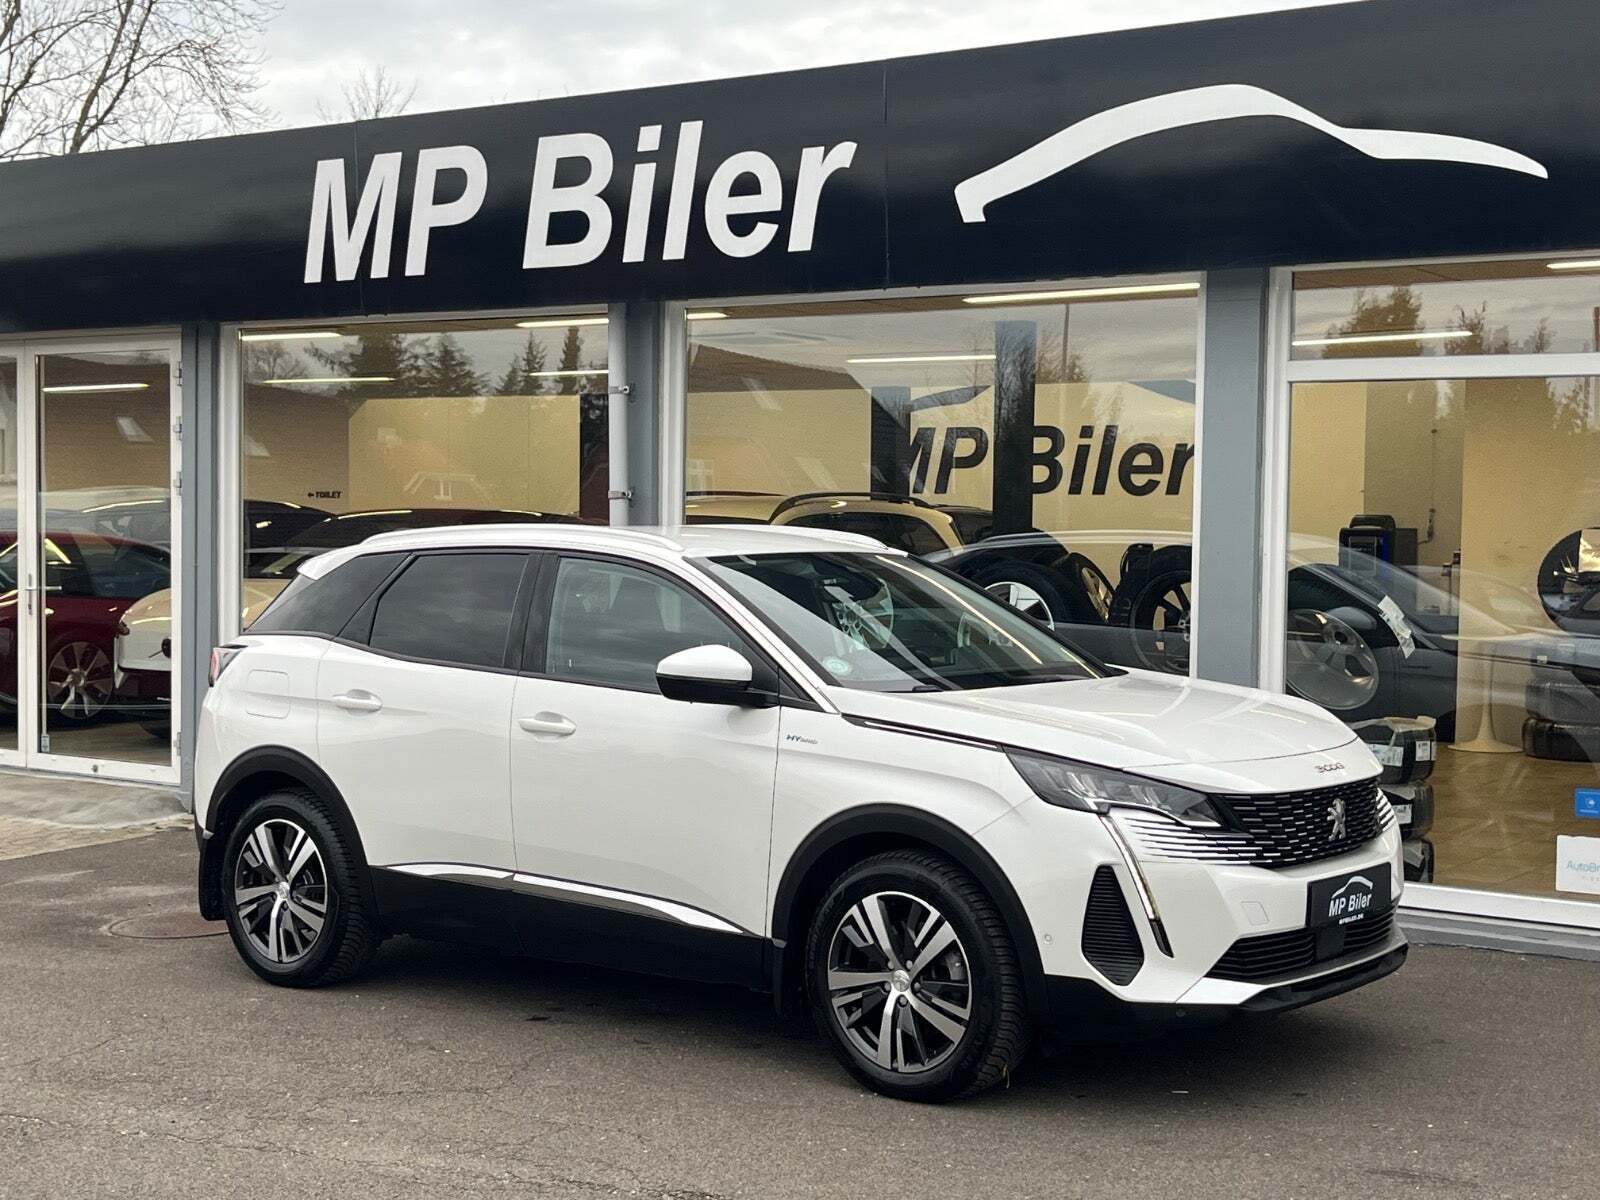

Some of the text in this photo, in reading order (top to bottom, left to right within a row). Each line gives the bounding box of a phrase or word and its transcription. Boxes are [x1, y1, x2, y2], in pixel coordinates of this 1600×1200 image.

[304, 120, 858, 284] MP Biler
[1328, 892, 1372, 917] MP Biler
